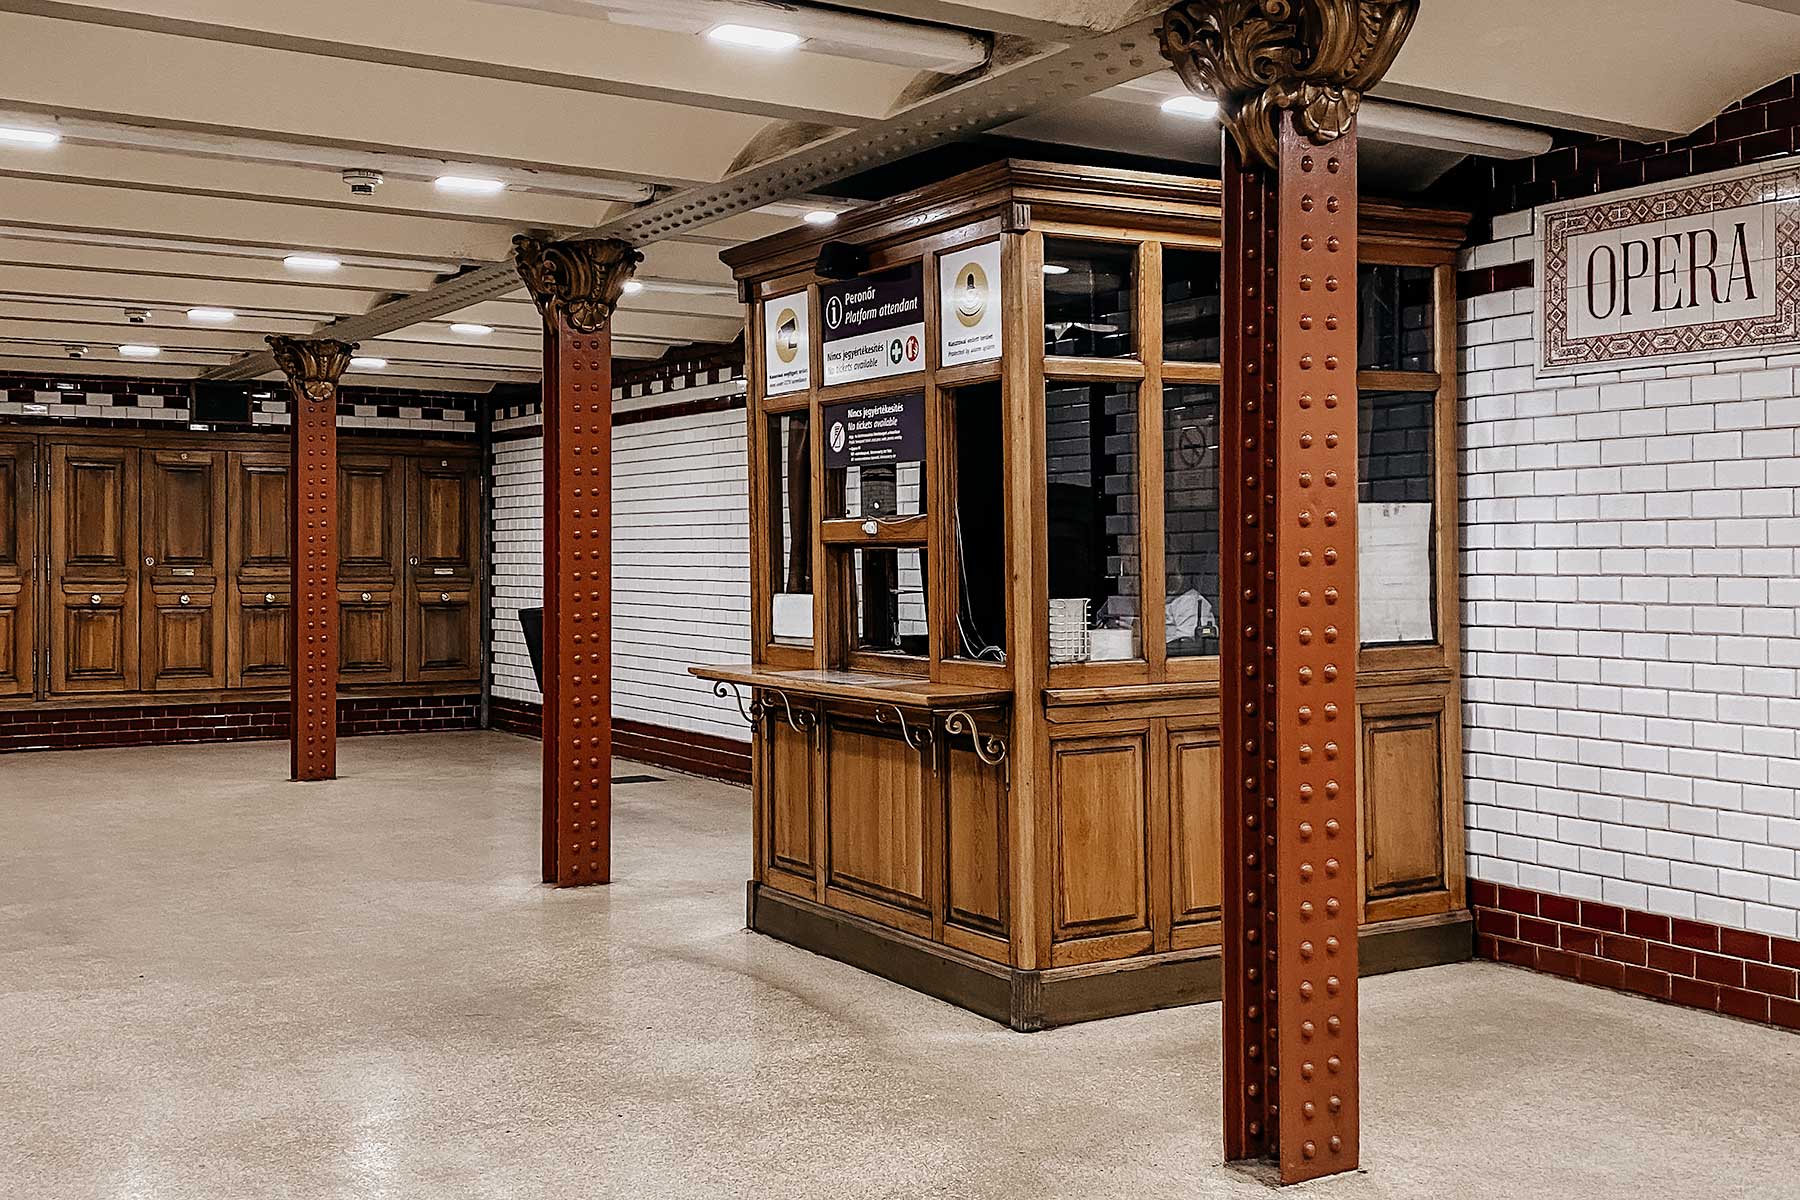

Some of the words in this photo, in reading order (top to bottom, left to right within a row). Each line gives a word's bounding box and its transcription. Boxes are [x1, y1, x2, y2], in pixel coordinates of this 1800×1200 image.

[1587, 222, 1758, 319] OPERA
[844, 286, 876, 306] Peronőr
[844, 307, 877, 326] Platform
[878, 296, 918, 317] attendant
[827, 351, 842, 361] Nincs
[853, 357, 878, 371] available
[847, 408, 862, 419] Nincs
[847, 421, 856, 431] No
[856, 419, 873, 430] tickets
[873, 416, 898, 429] available
